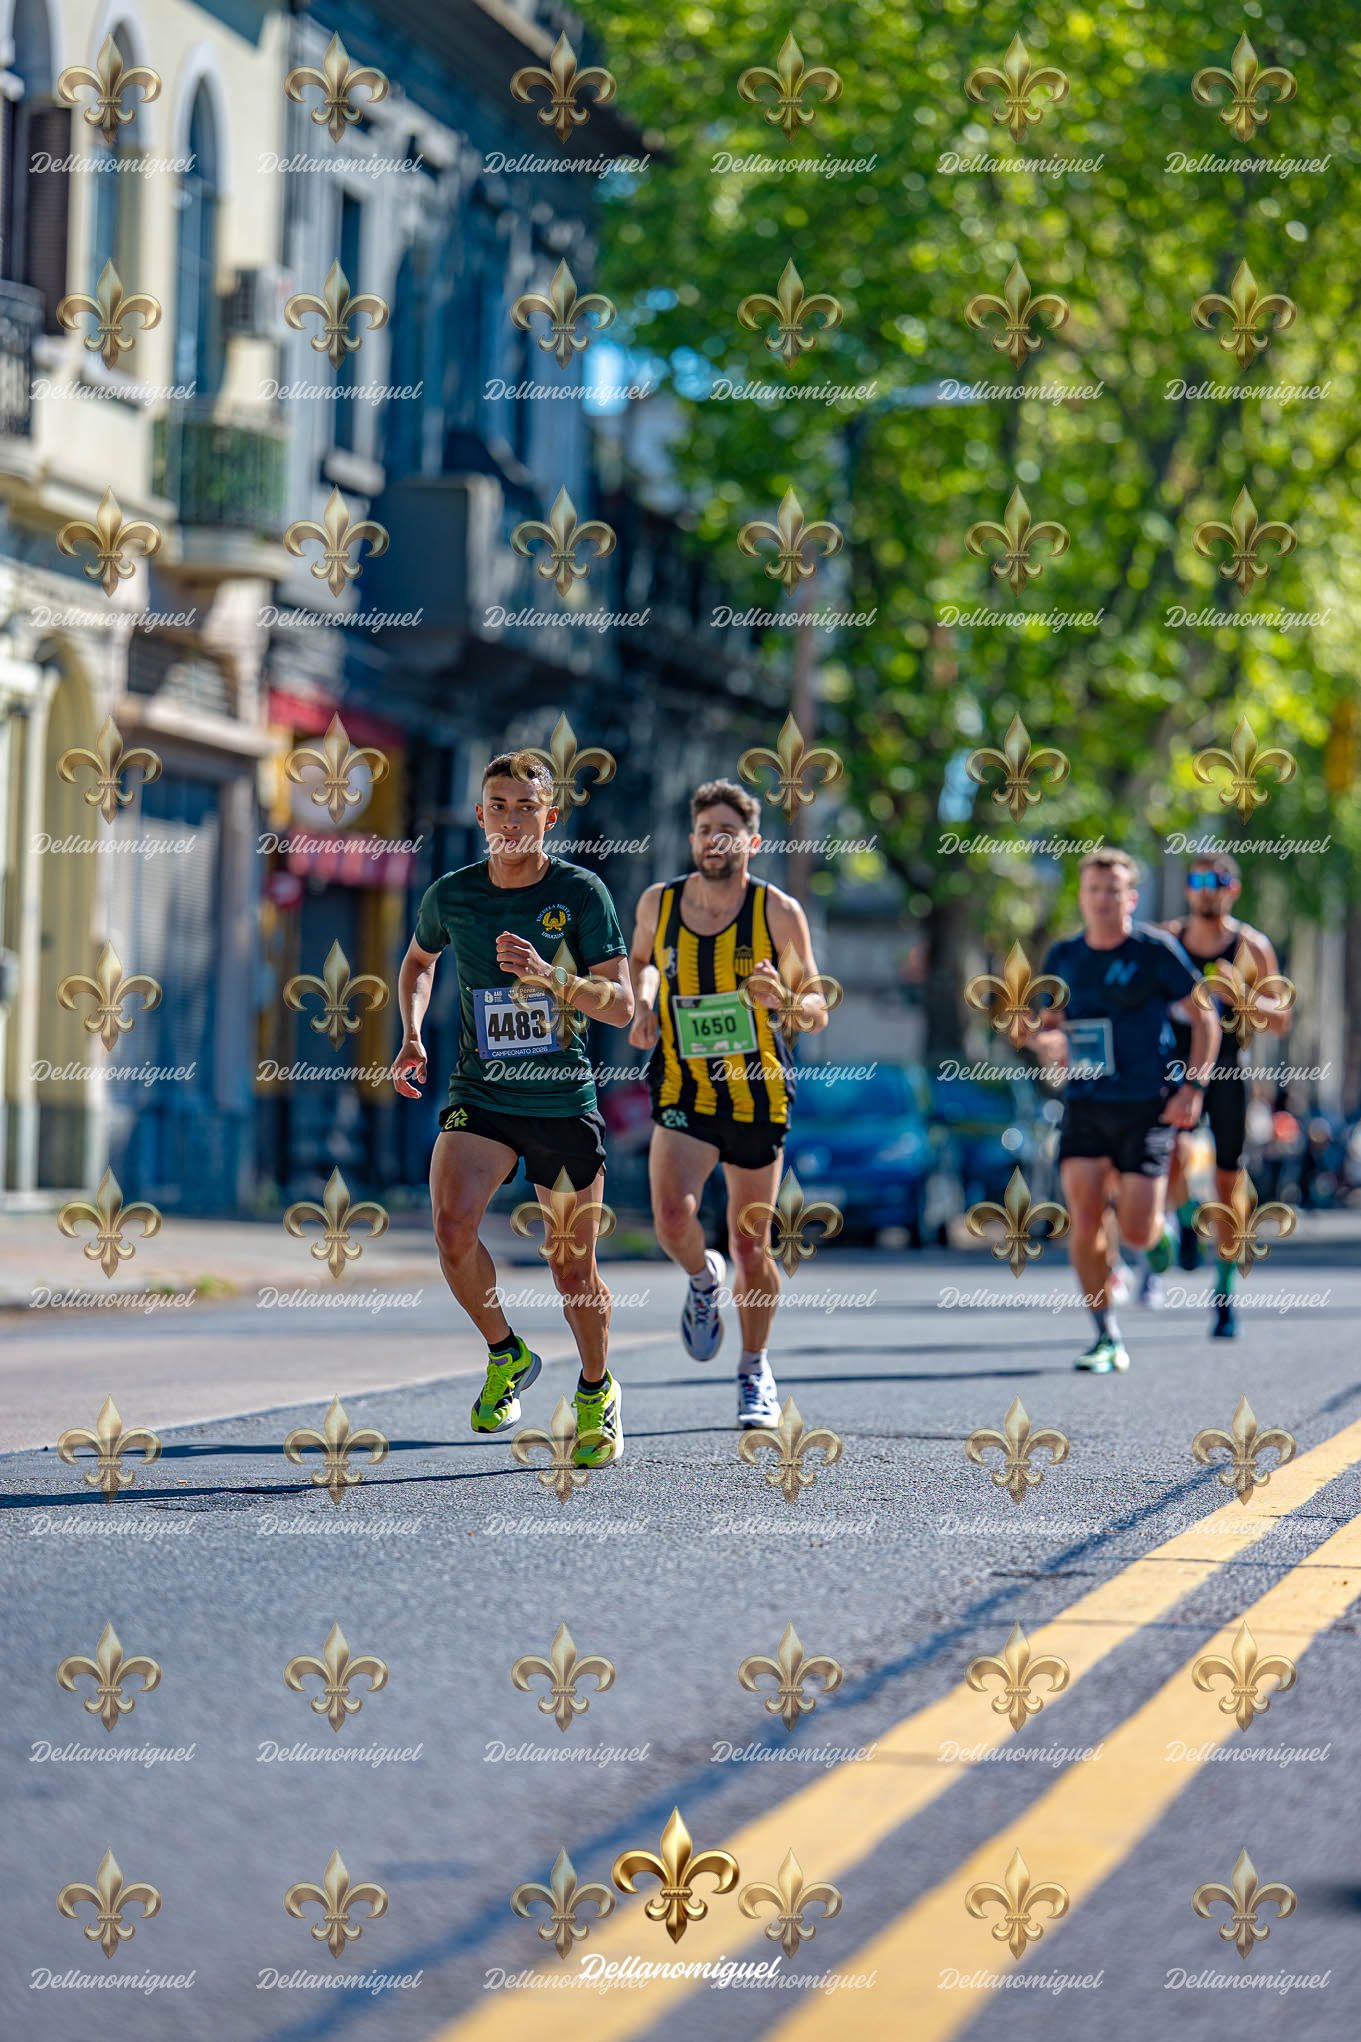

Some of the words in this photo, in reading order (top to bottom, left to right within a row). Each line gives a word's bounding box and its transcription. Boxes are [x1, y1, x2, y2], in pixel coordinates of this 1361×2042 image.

[488, 1009, 547, 1042] 4483
[692, 1015, 736, 1036] 1650
[492, 1048, 532, 1057] CAMPEONATO
